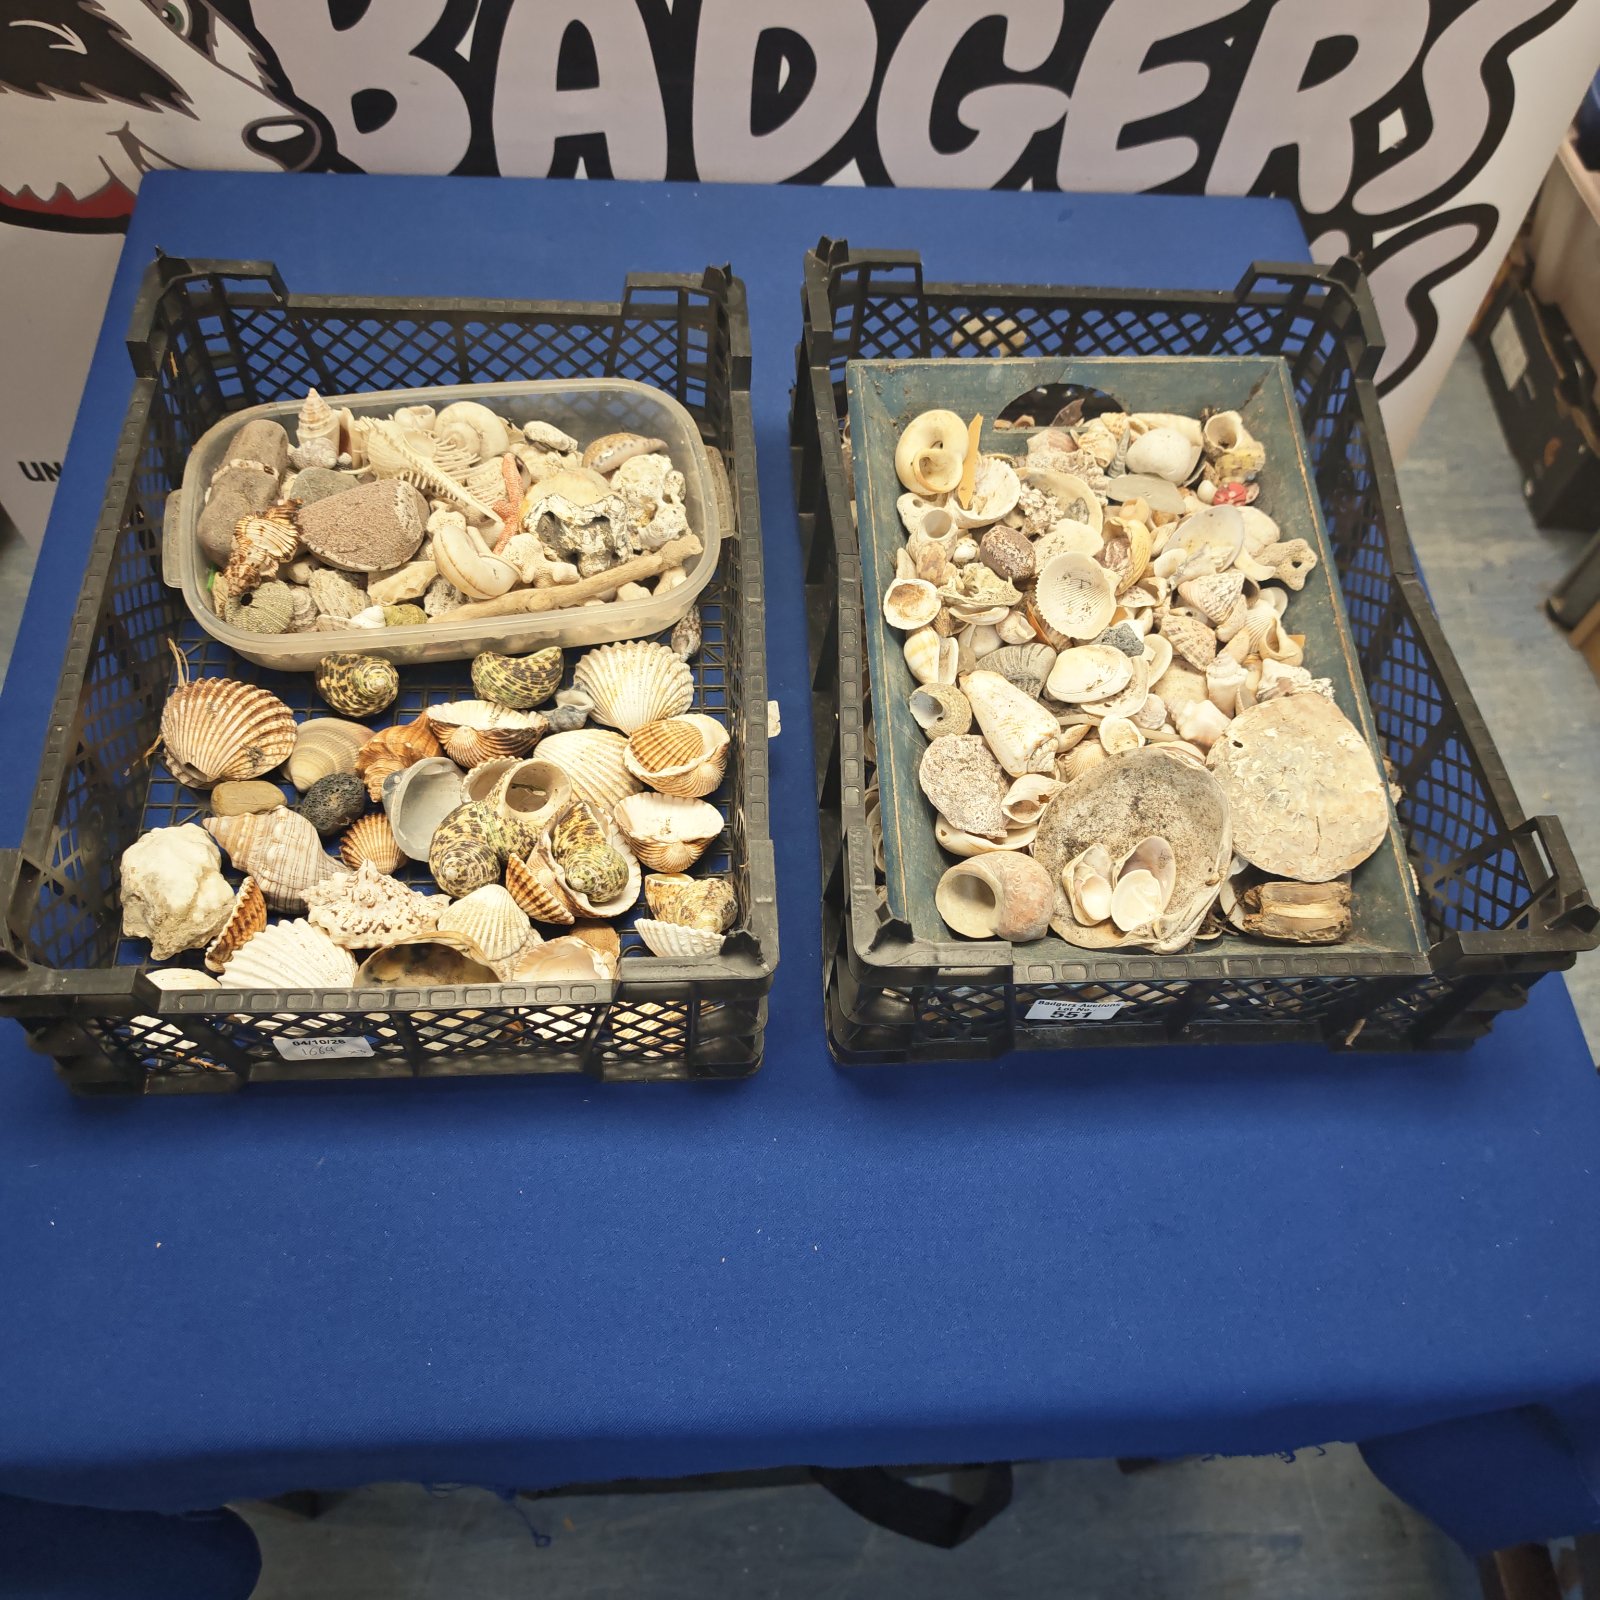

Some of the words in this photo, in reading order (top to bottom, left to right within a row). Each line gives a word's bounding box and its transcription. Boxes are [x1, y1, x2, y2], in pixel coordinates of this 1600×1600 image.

[252, 0, 1560, 214] BADGERS
[1038, 1000, 1077, 1008] Badgers
[1050, 1010, 1093, 1018] 551
